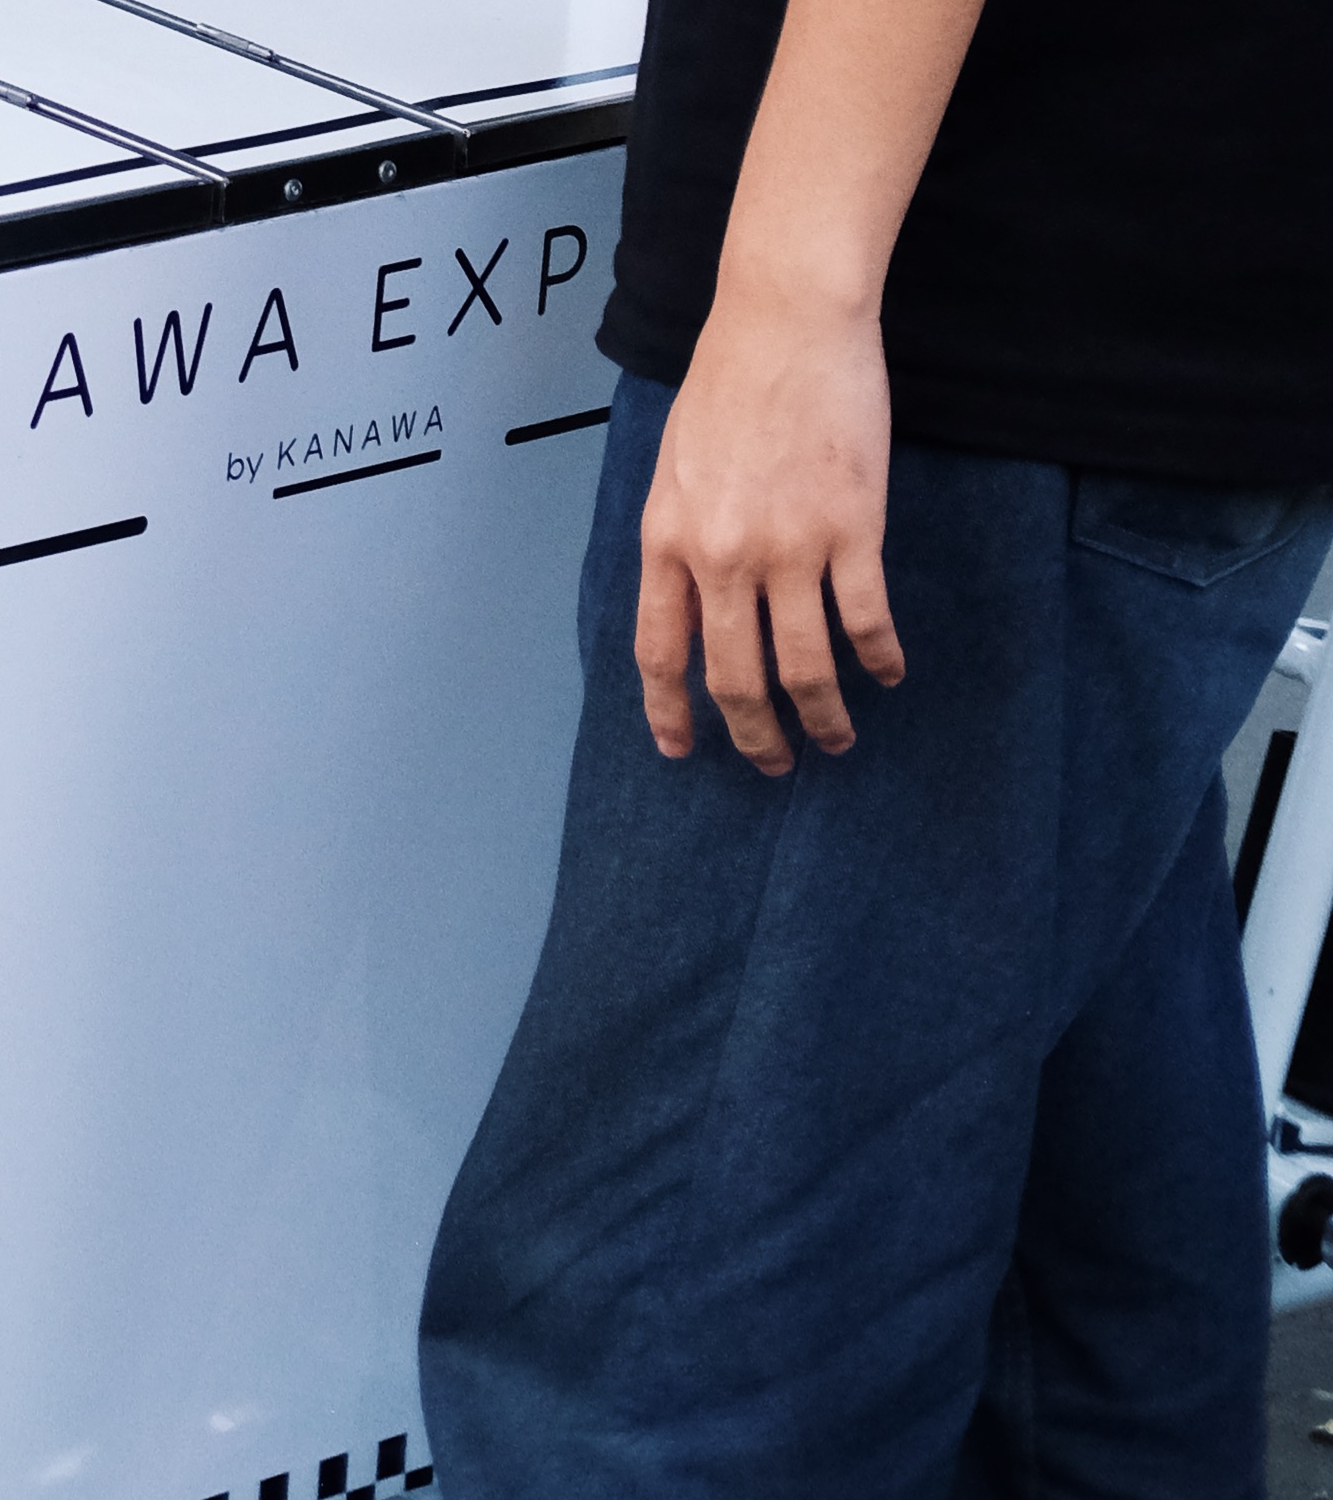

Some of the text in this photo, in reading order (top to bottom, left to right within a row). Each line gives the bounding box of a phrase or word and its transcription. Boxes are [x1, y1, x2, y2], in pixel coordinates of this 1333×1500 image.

[371, 224, 588, 353] EXP
[226, 404, 444, 484] by KANAWA
